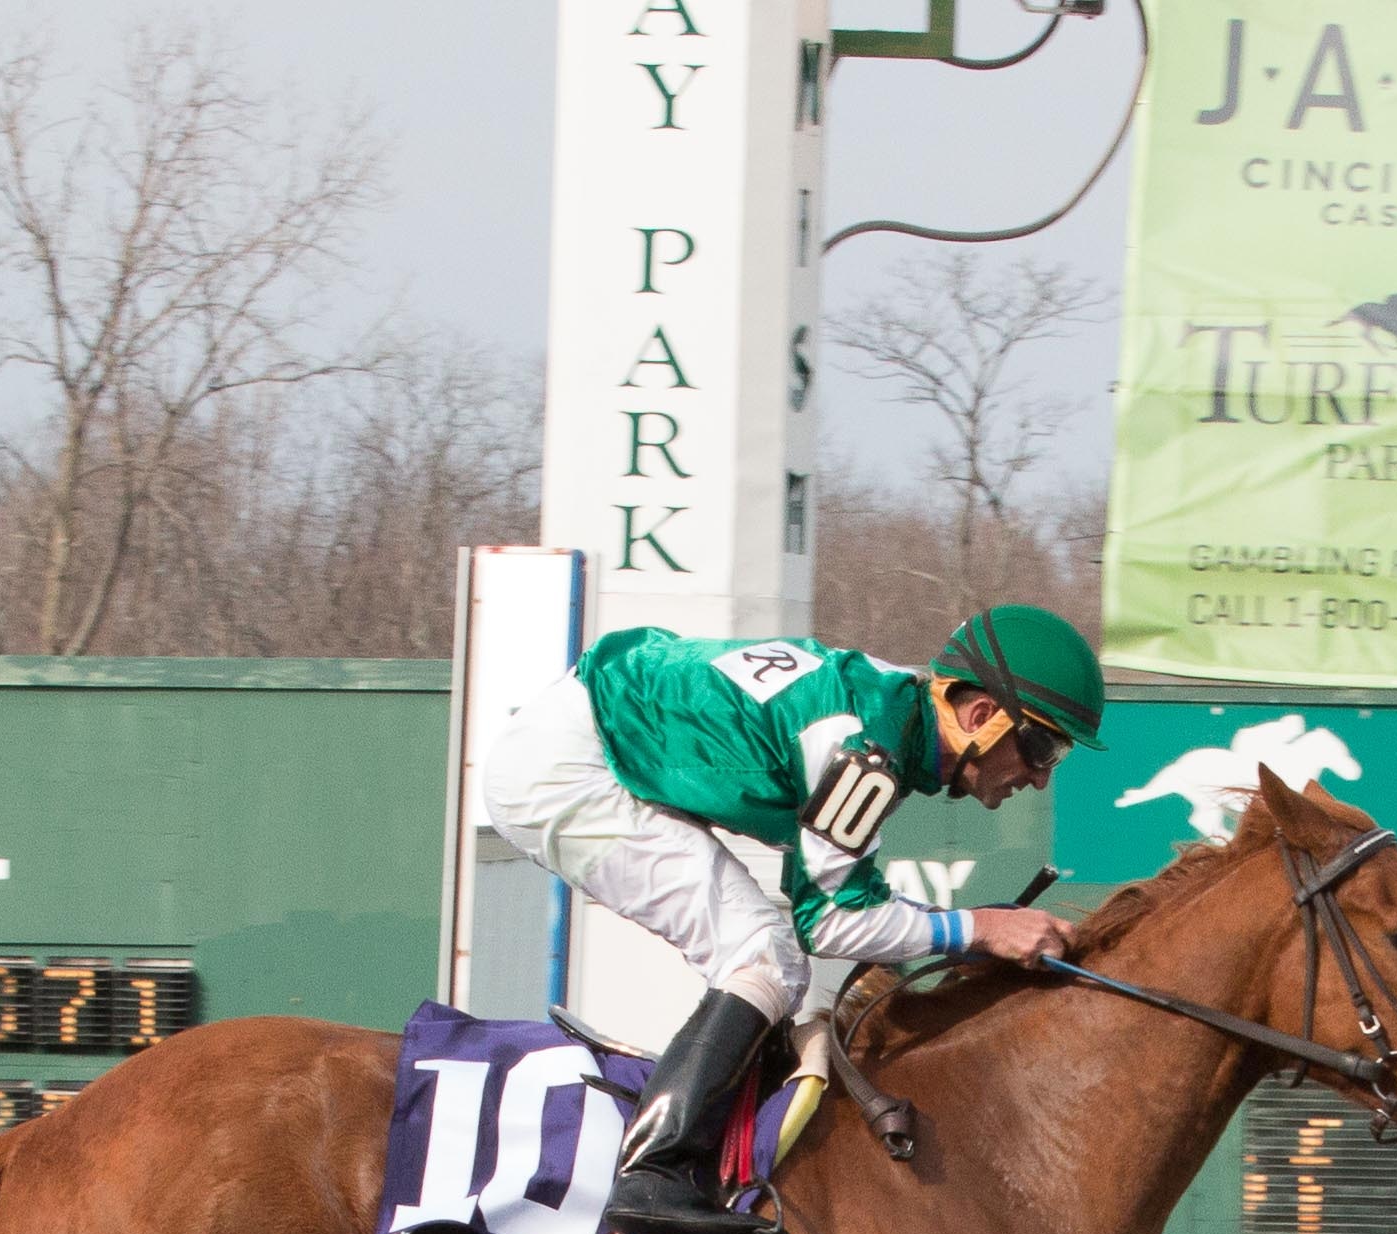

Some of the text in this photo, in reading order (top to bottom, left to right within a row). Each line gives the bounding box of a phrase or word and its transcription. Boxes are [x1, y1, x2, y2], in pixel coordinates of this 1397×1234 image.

[611, 225, 700, 573] PARK
[1188, 543, 1379, 578] GAMBLING
[1186, 593, 1273, 627] CALL
[813, 760, 896, 850] 10
